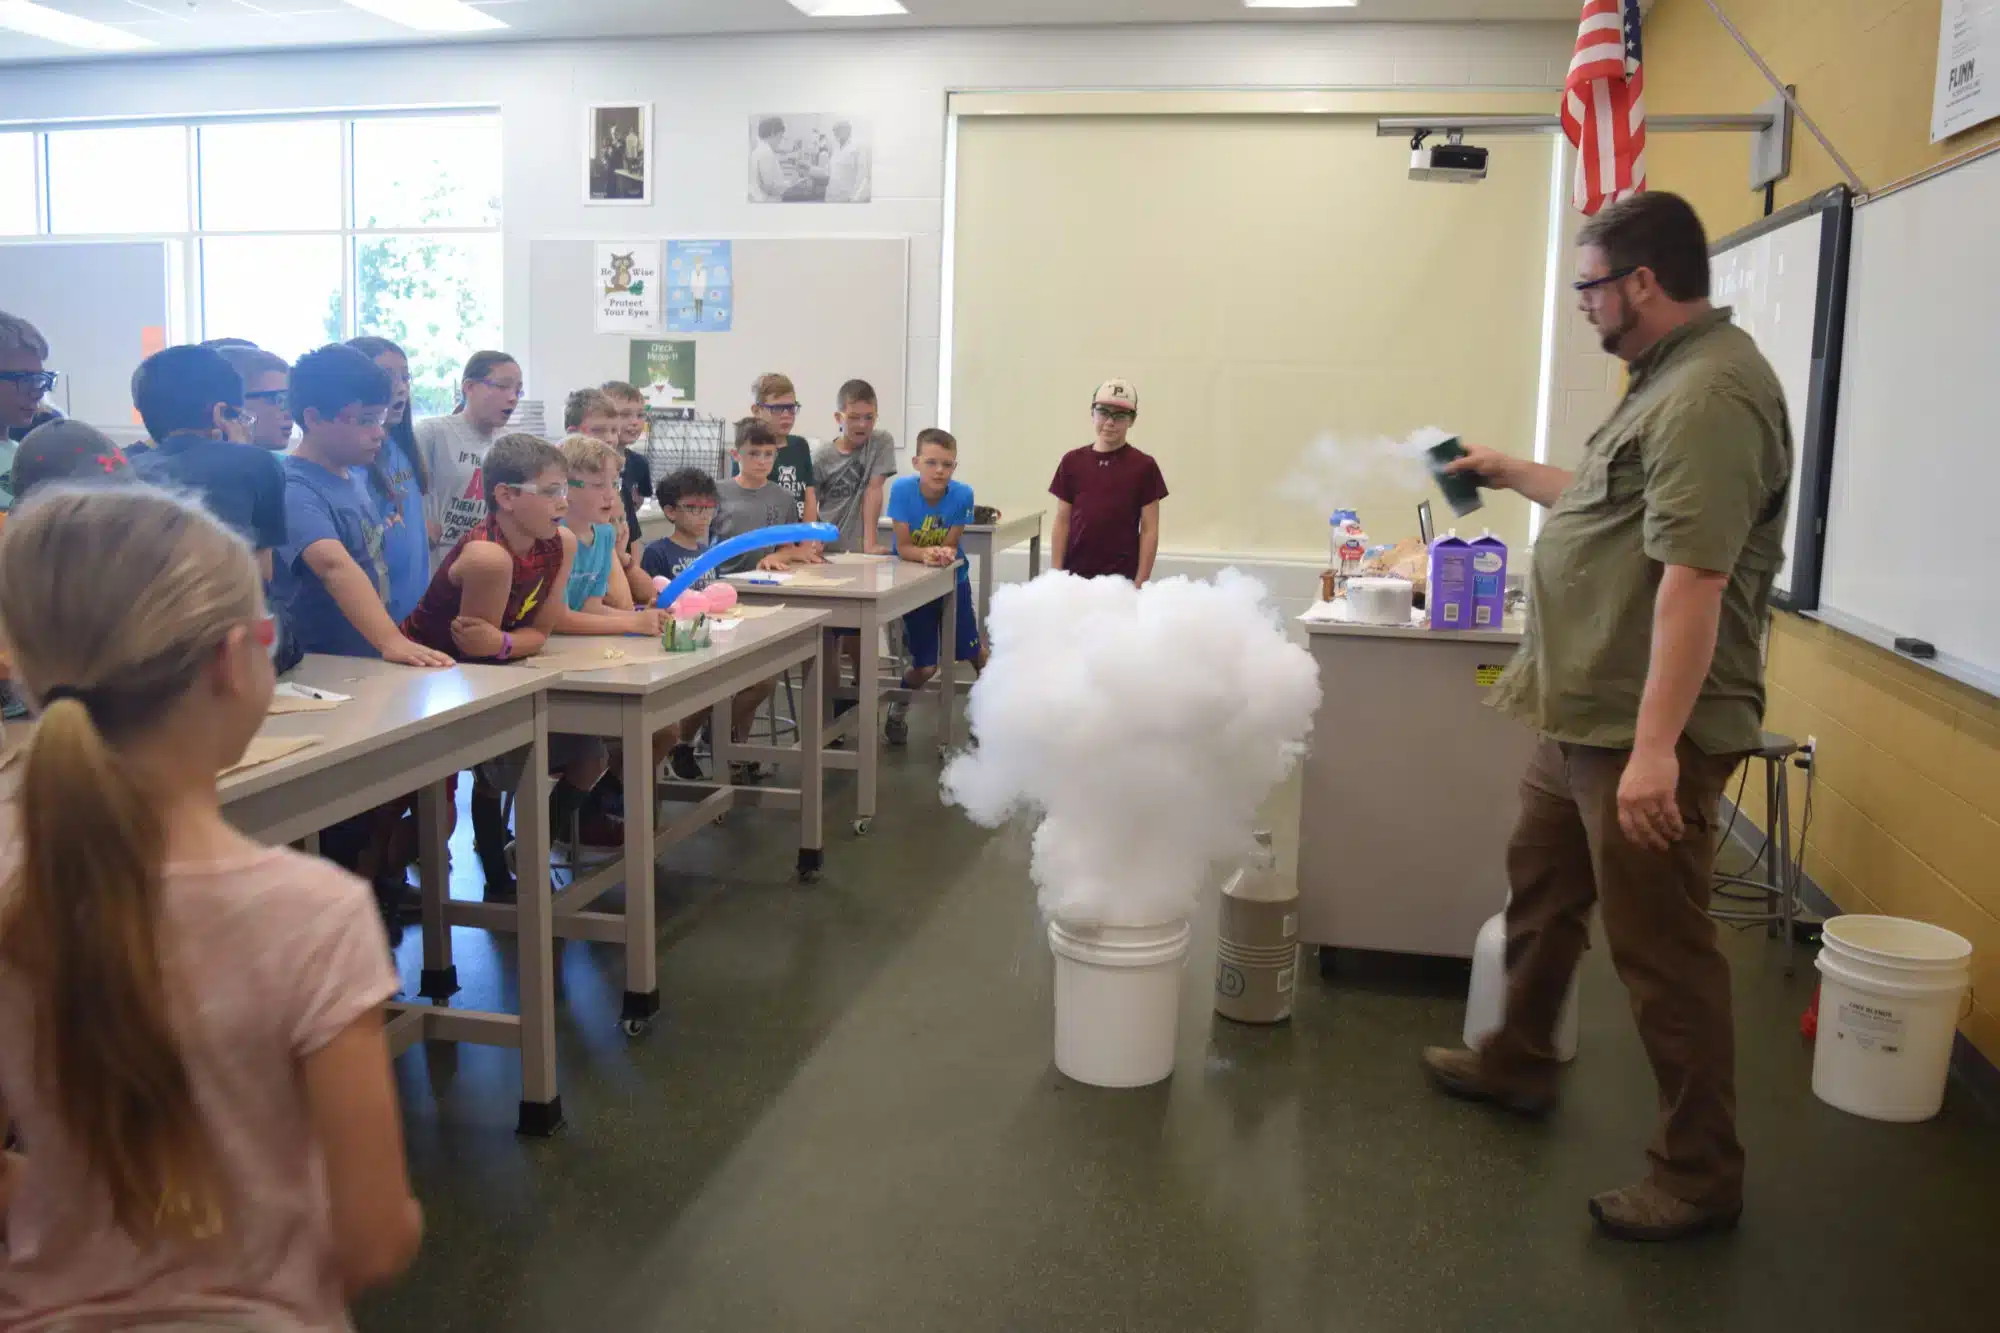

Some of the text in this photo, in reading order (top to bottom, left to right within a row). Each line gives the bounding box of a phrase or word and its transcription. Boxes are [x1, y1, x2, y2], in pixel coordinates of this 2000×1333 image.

[1948, 57, 1975, 92] FLINN
[610, 299, 643, 307] Protect
[604, 308, 649, 318] Your Eyes
[459, 451, 469, 463] IF
[452, 497, 475, 513] THEN
[444, 527, 460, 539] OF
